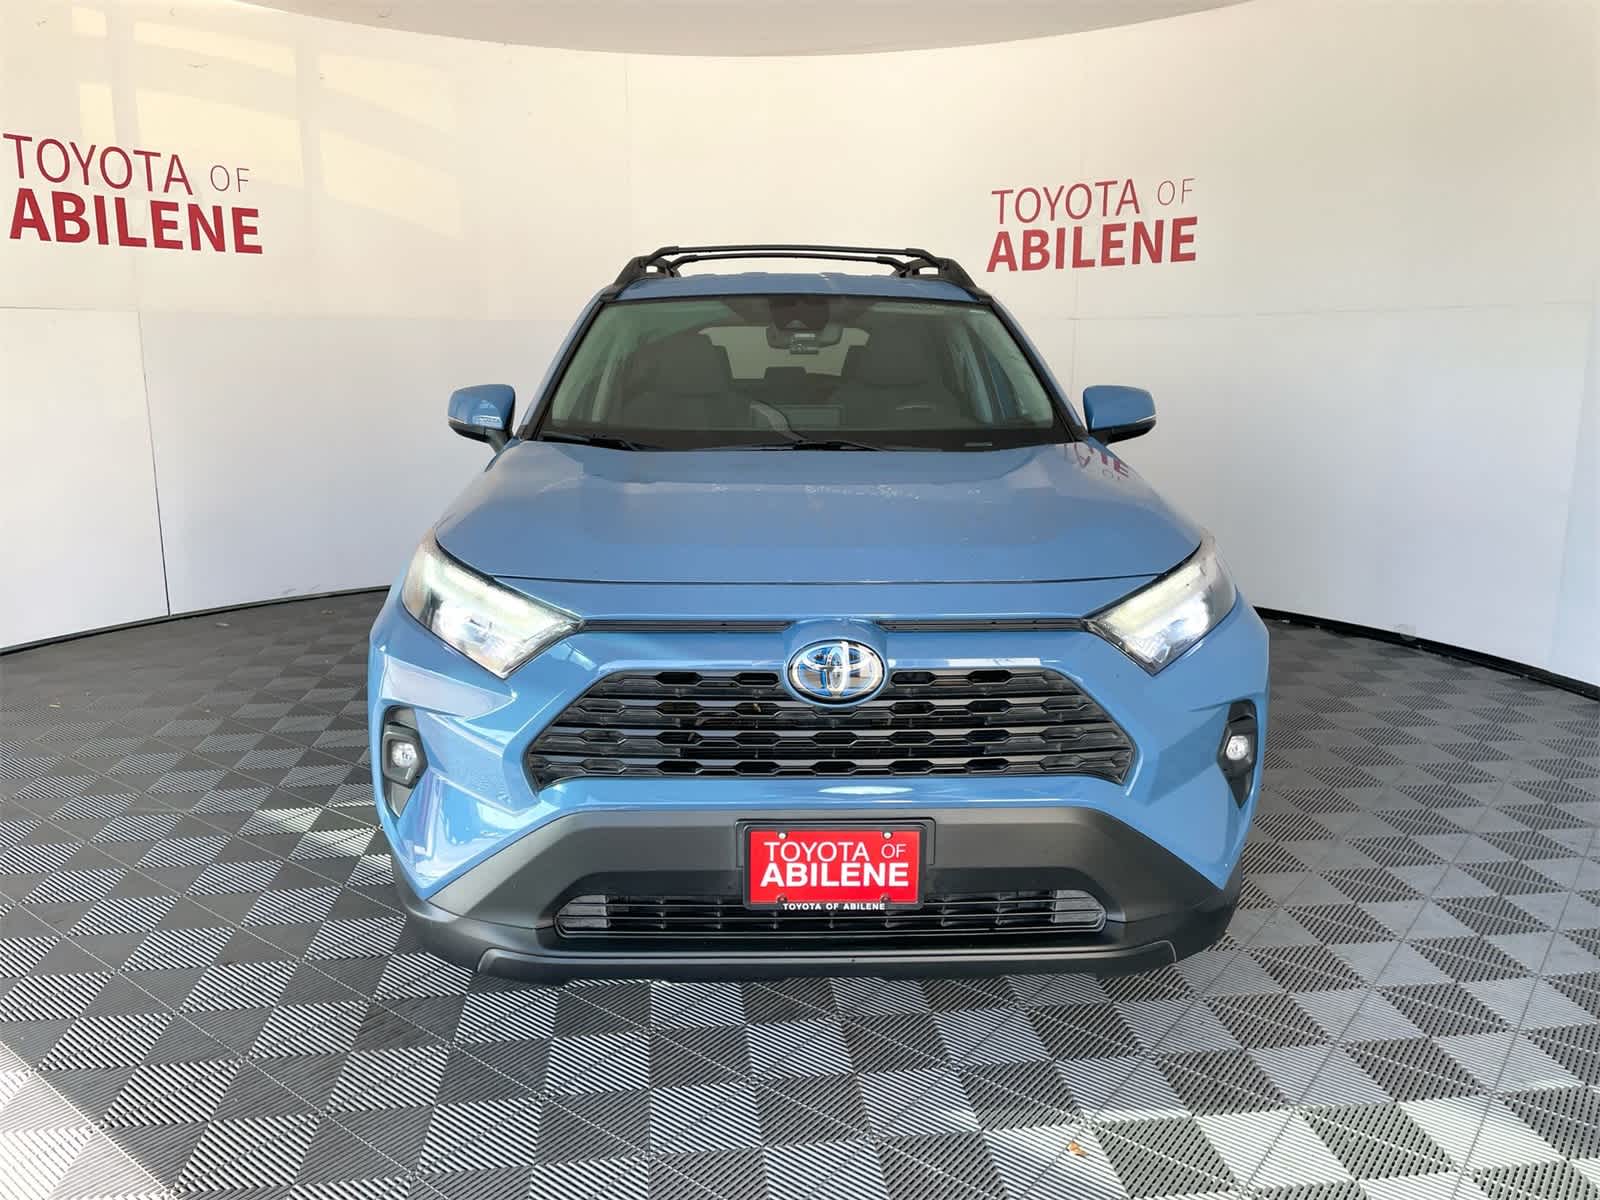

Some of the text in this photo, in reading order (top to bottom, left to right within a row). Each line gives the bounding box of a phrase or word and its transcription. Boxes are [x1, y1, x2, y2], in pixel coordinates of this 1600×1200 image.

[3, 133, 250, 195] TOYOTA OF
[9, 187, 263, 254] ABILENE
[992, 178, 1195, 224] TOYOTA OF
[986, 216, 1198, 272] ABILENE
[760, 862, 909, 887] ABILENE
[764, 841, 906, 862] TOYOTA OF
